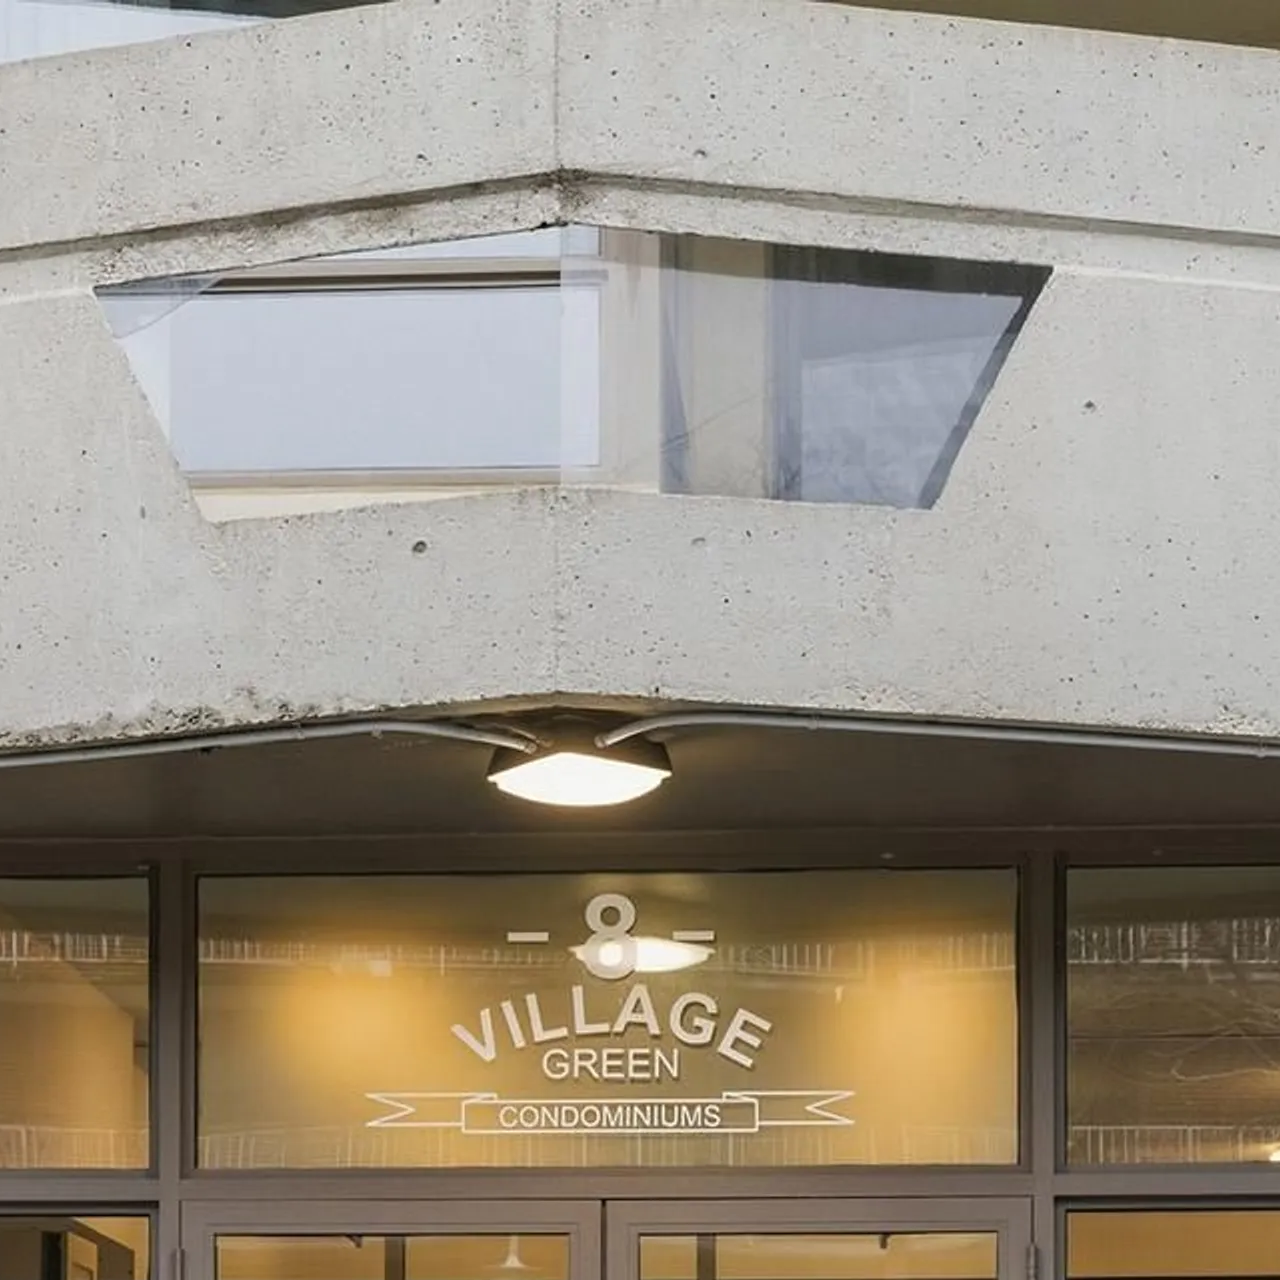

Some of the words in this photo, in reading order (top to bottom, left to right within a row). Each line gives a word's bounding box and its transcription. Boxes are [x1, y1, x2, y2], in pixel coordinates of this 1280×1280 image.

[585, 893, 636, 980] 8
[450, 983, 773, 1069] VILLAGE
[542, 1047, 680, 1080] GREEN
[499, 1105, 722, 1129] CONDOMINIUMS
